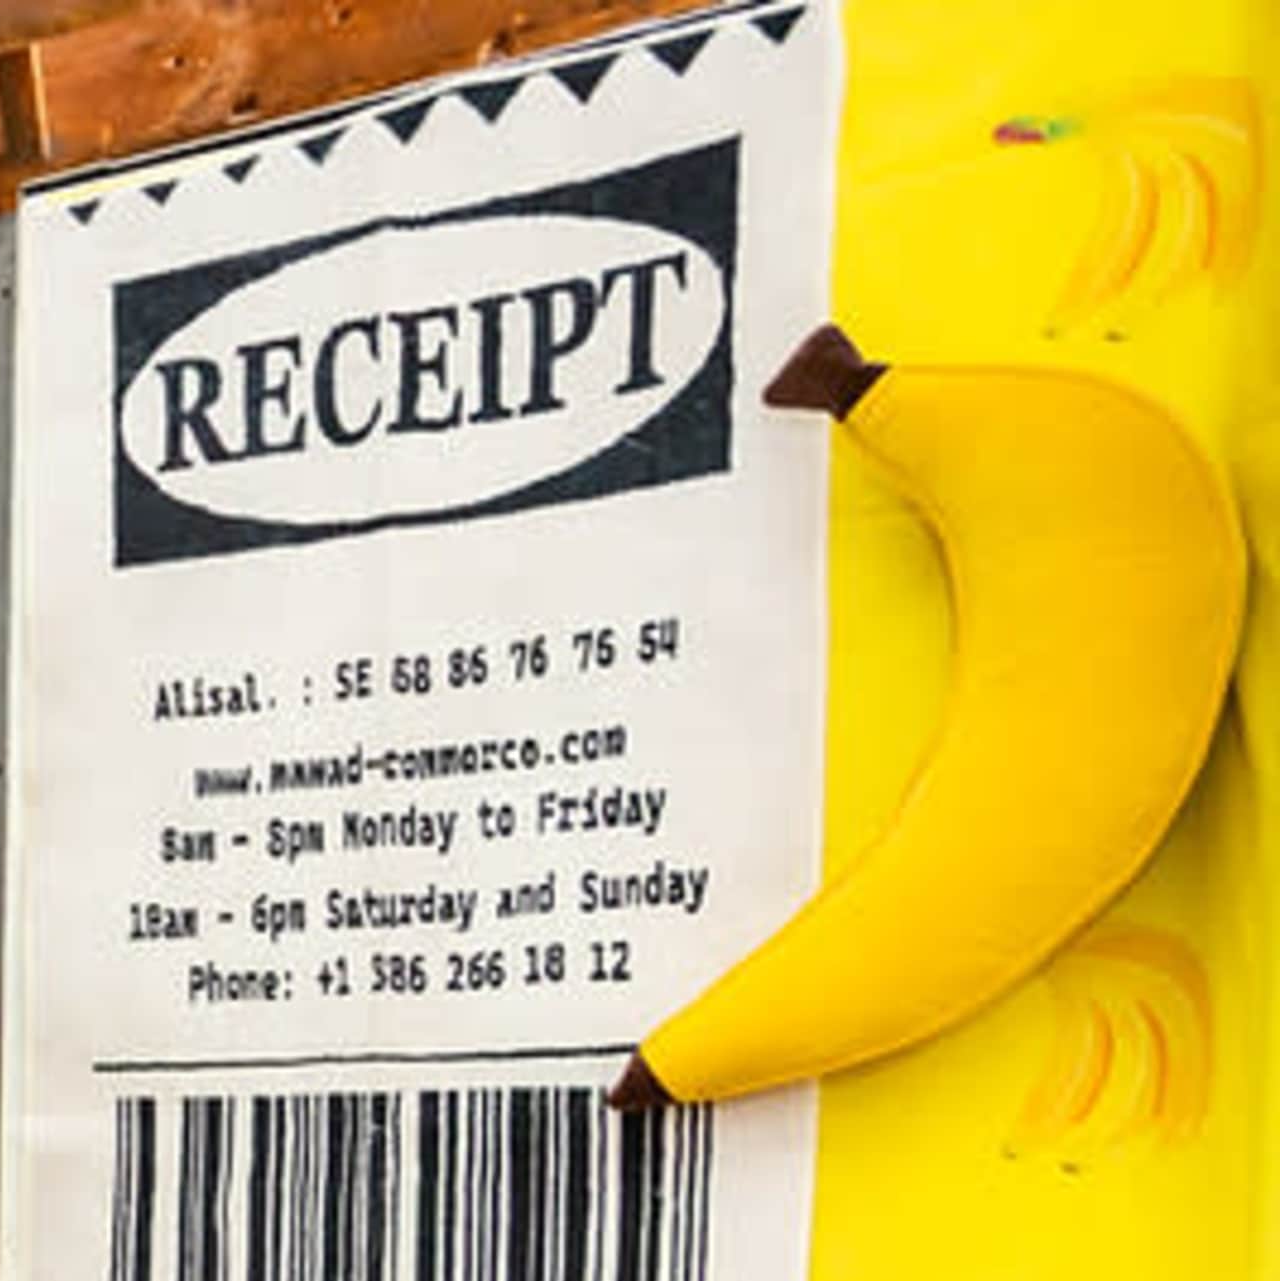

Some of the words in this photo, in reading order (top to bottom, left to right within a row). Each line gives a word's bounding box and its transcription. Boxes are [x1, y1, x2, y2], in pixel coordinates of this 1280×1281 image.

[155, 251, 689, 474] RECEIPT
[334, 657, 372, 700] SE
[509, 634, 549, 681] 76
[637, 618, 679, 665] 54
[161, 826, 216, 864] 8am
[266, 817, 325, 865] 8pm
[342, 804, 458, 856] Monday
[477, 800, 516, 840] to
[537, 786, 667, 837] Friday
[250, 893, 307, 943] 6pm
[326, 883, 478, 933] Saturday
[496, 871, 556, 919] and
[579, 860, 709, 915] Sunday
[188, 961, 292, 1003] Phone:
[316, 955, 351, 997] +1
[445, 949, 507, 992] 266
[524, 942, 566, 985] 18
[589, 940, 631, 982] 12
